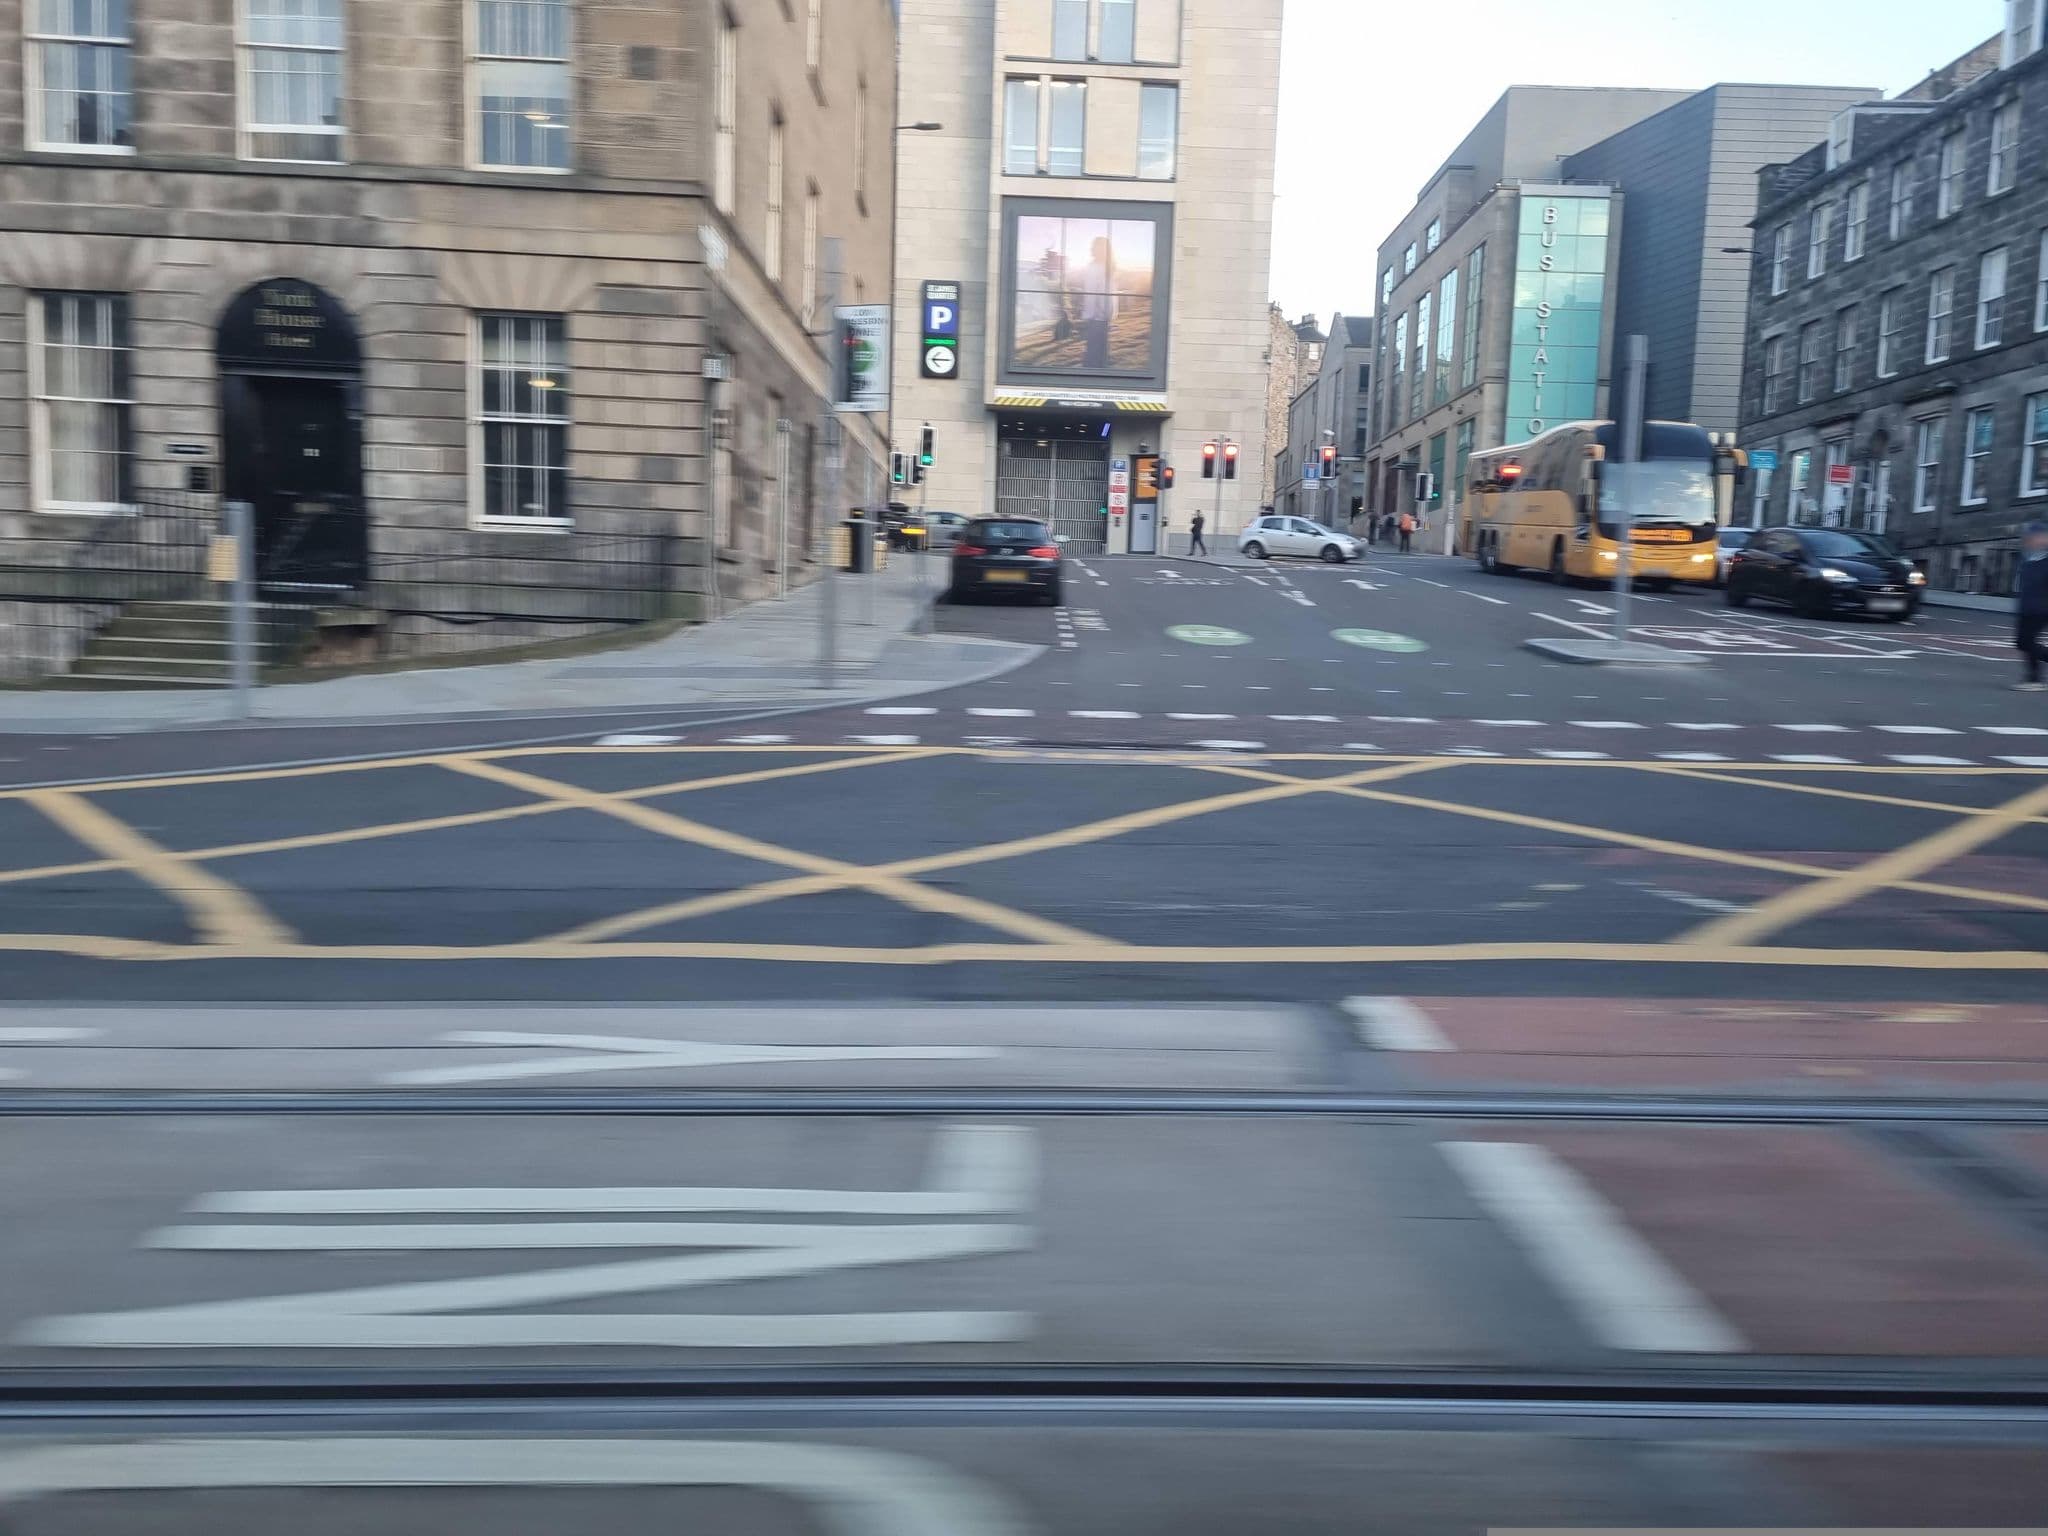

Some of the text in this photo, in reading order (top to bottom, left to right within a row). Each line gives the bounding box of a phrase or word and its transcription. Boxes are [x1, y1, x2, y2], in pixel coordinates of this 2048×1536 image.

[930, 305, 953, 330] P
[1528, 206, 1559, 434] BUS STATIO
